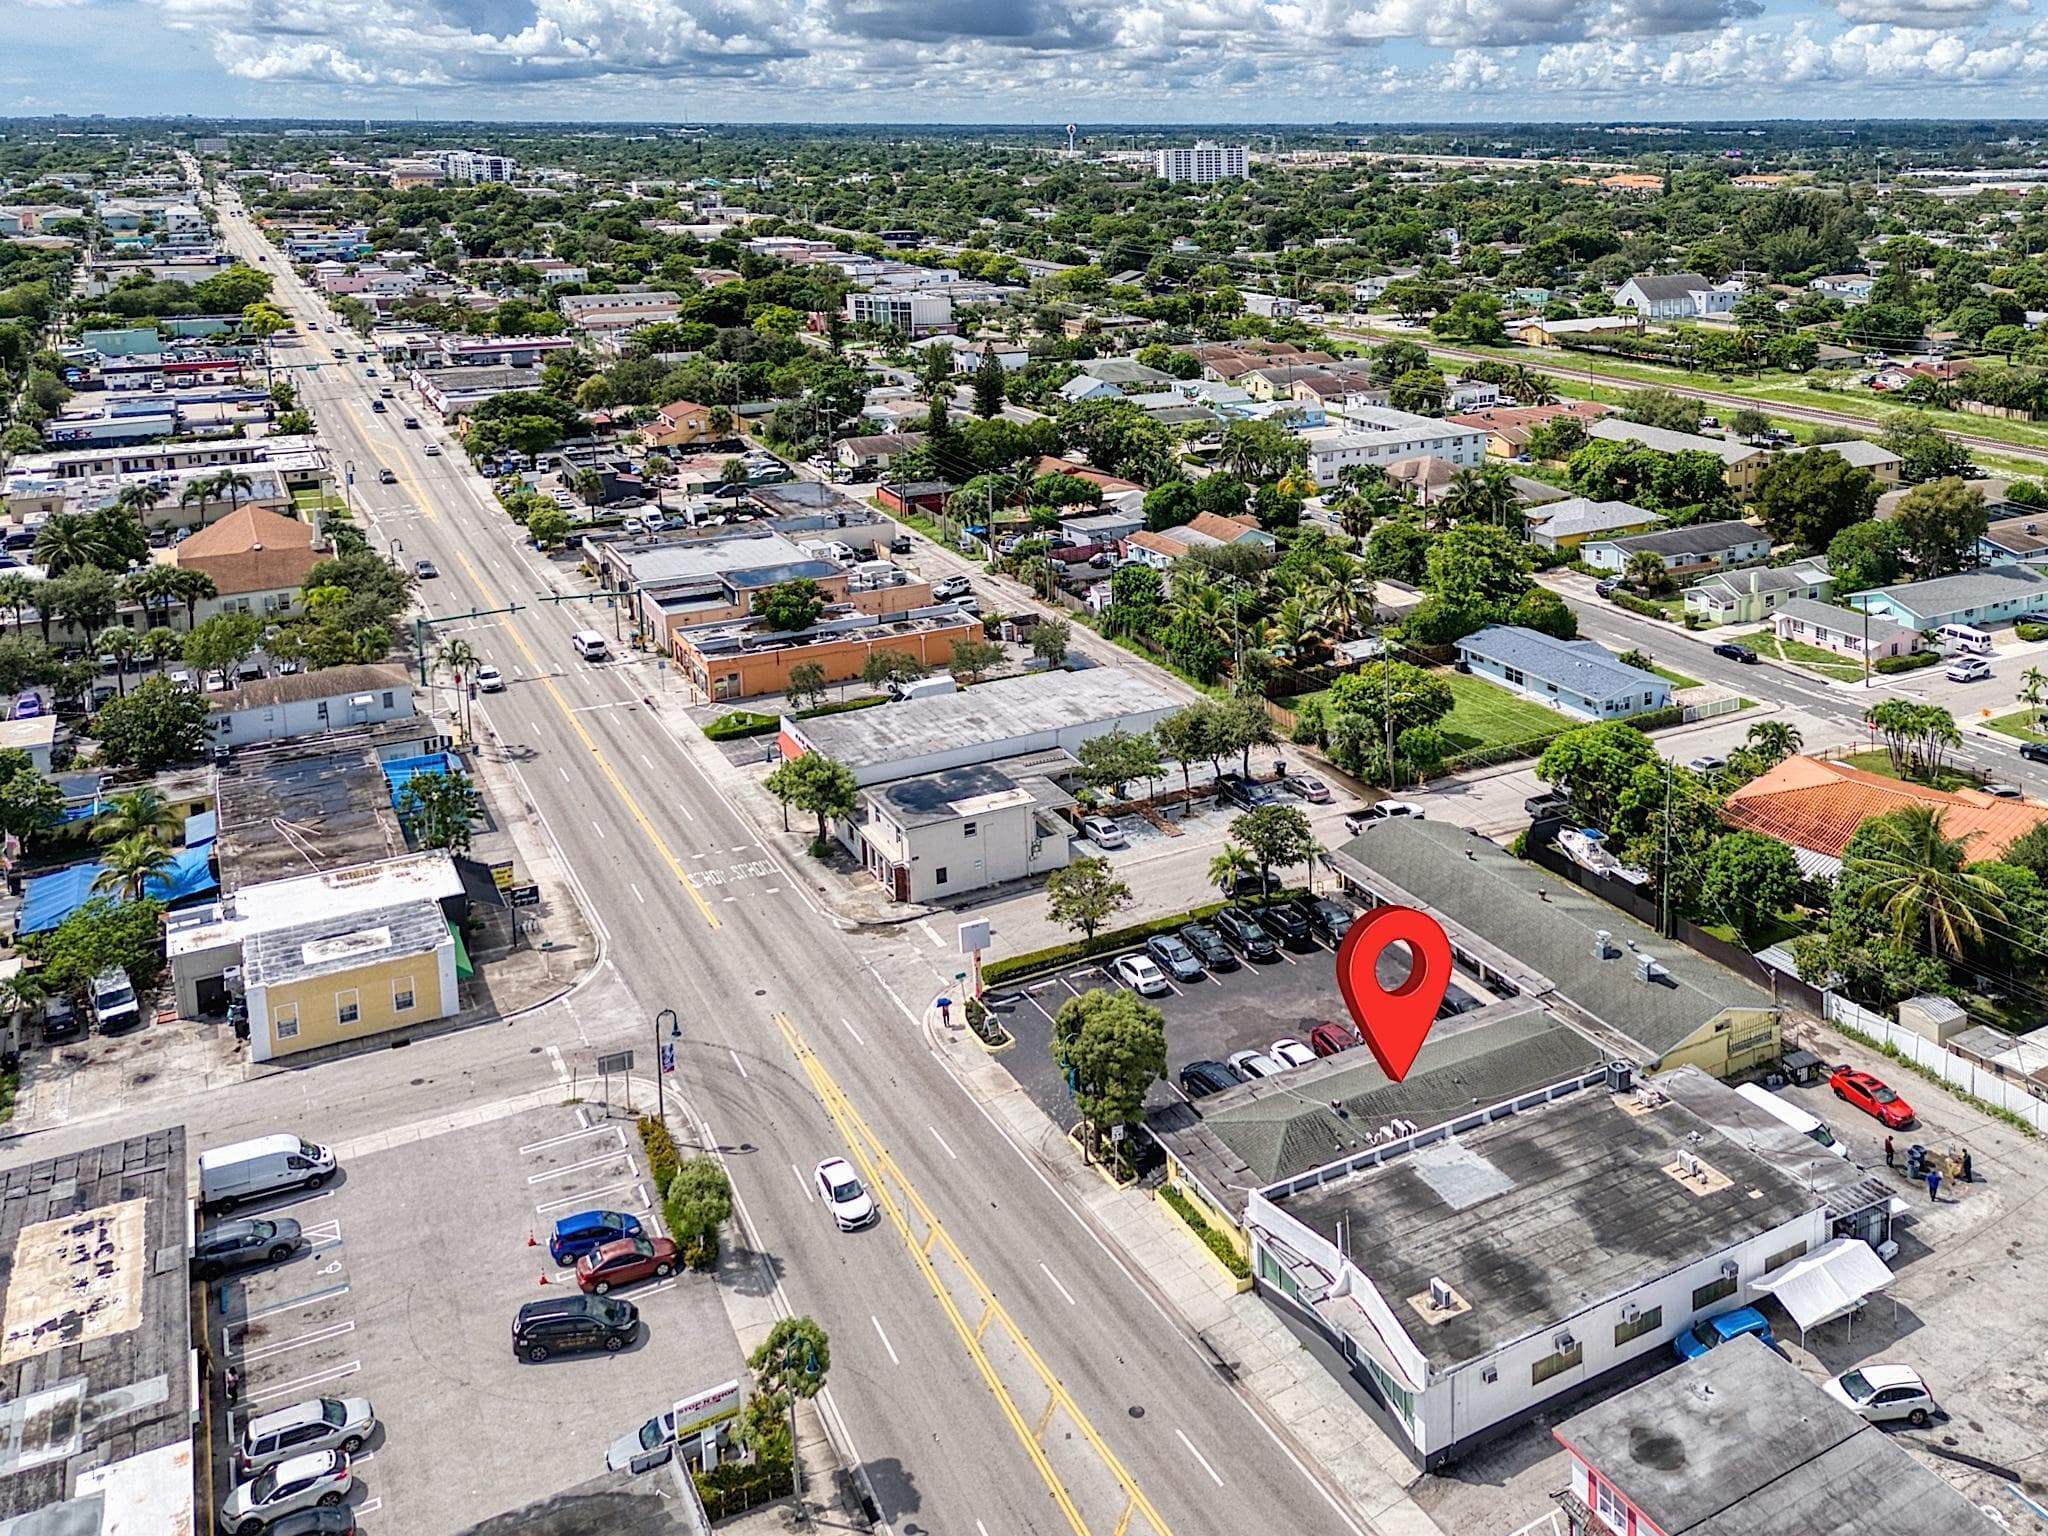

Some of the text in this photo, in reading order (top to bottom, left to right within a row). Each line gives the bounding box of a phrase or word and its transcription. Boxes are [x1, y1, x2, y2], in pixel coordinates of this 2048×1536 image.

[56, 429, 91, 440] FedEx
[677, 1402, 701, 1414] STOP
[712, 1388, 737, 1401] SHOP
